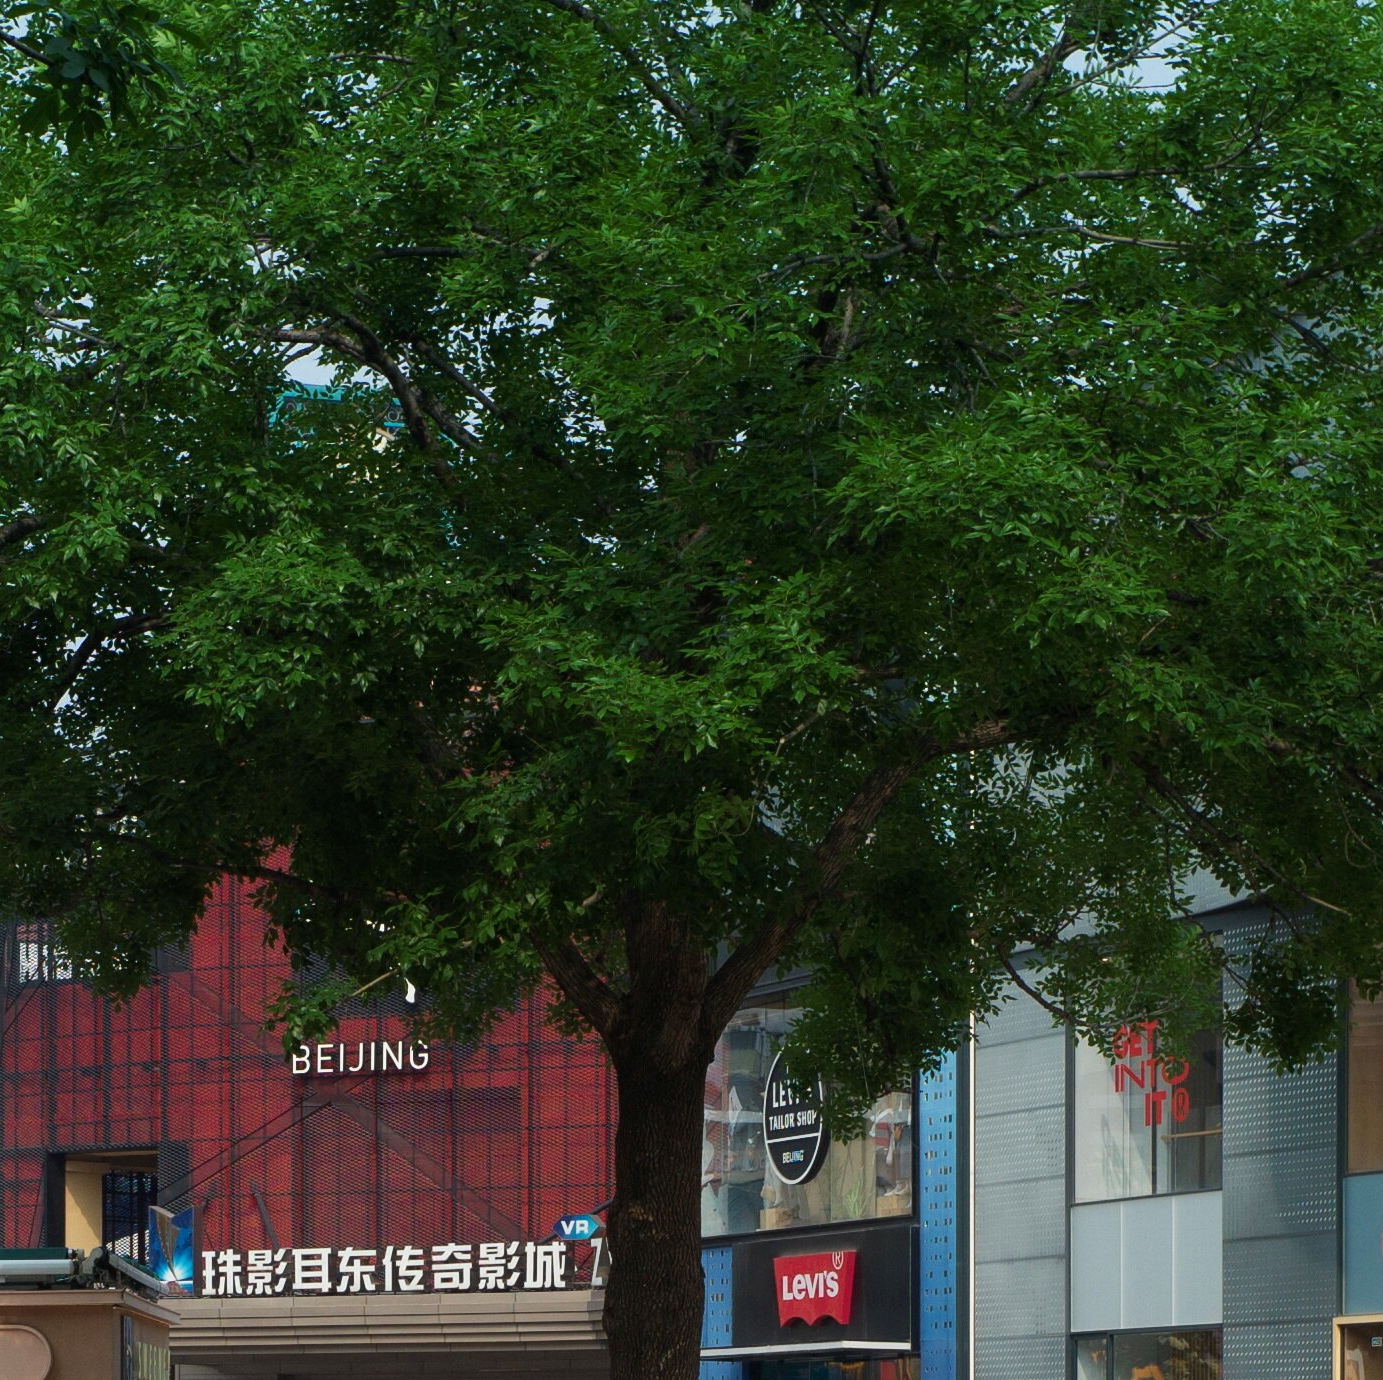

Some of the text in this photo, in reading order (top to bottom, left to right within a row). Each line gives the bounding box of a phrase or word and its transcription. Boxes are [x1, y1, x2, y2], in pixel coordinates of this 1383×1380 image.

[292, 1040, 429, 1074] BEIJING
[1114, 1056, 1191, 1092] INTO
[769, 1112, 796, 1131] TAILOR
[1145, 1091, 1167, 1126] IT
[782, 1150, 805, 1163] BEIJING
[561, 1220, 590, 1235] VR
[202, 1241, 567, 1296] 珠影耳东传奇影城
